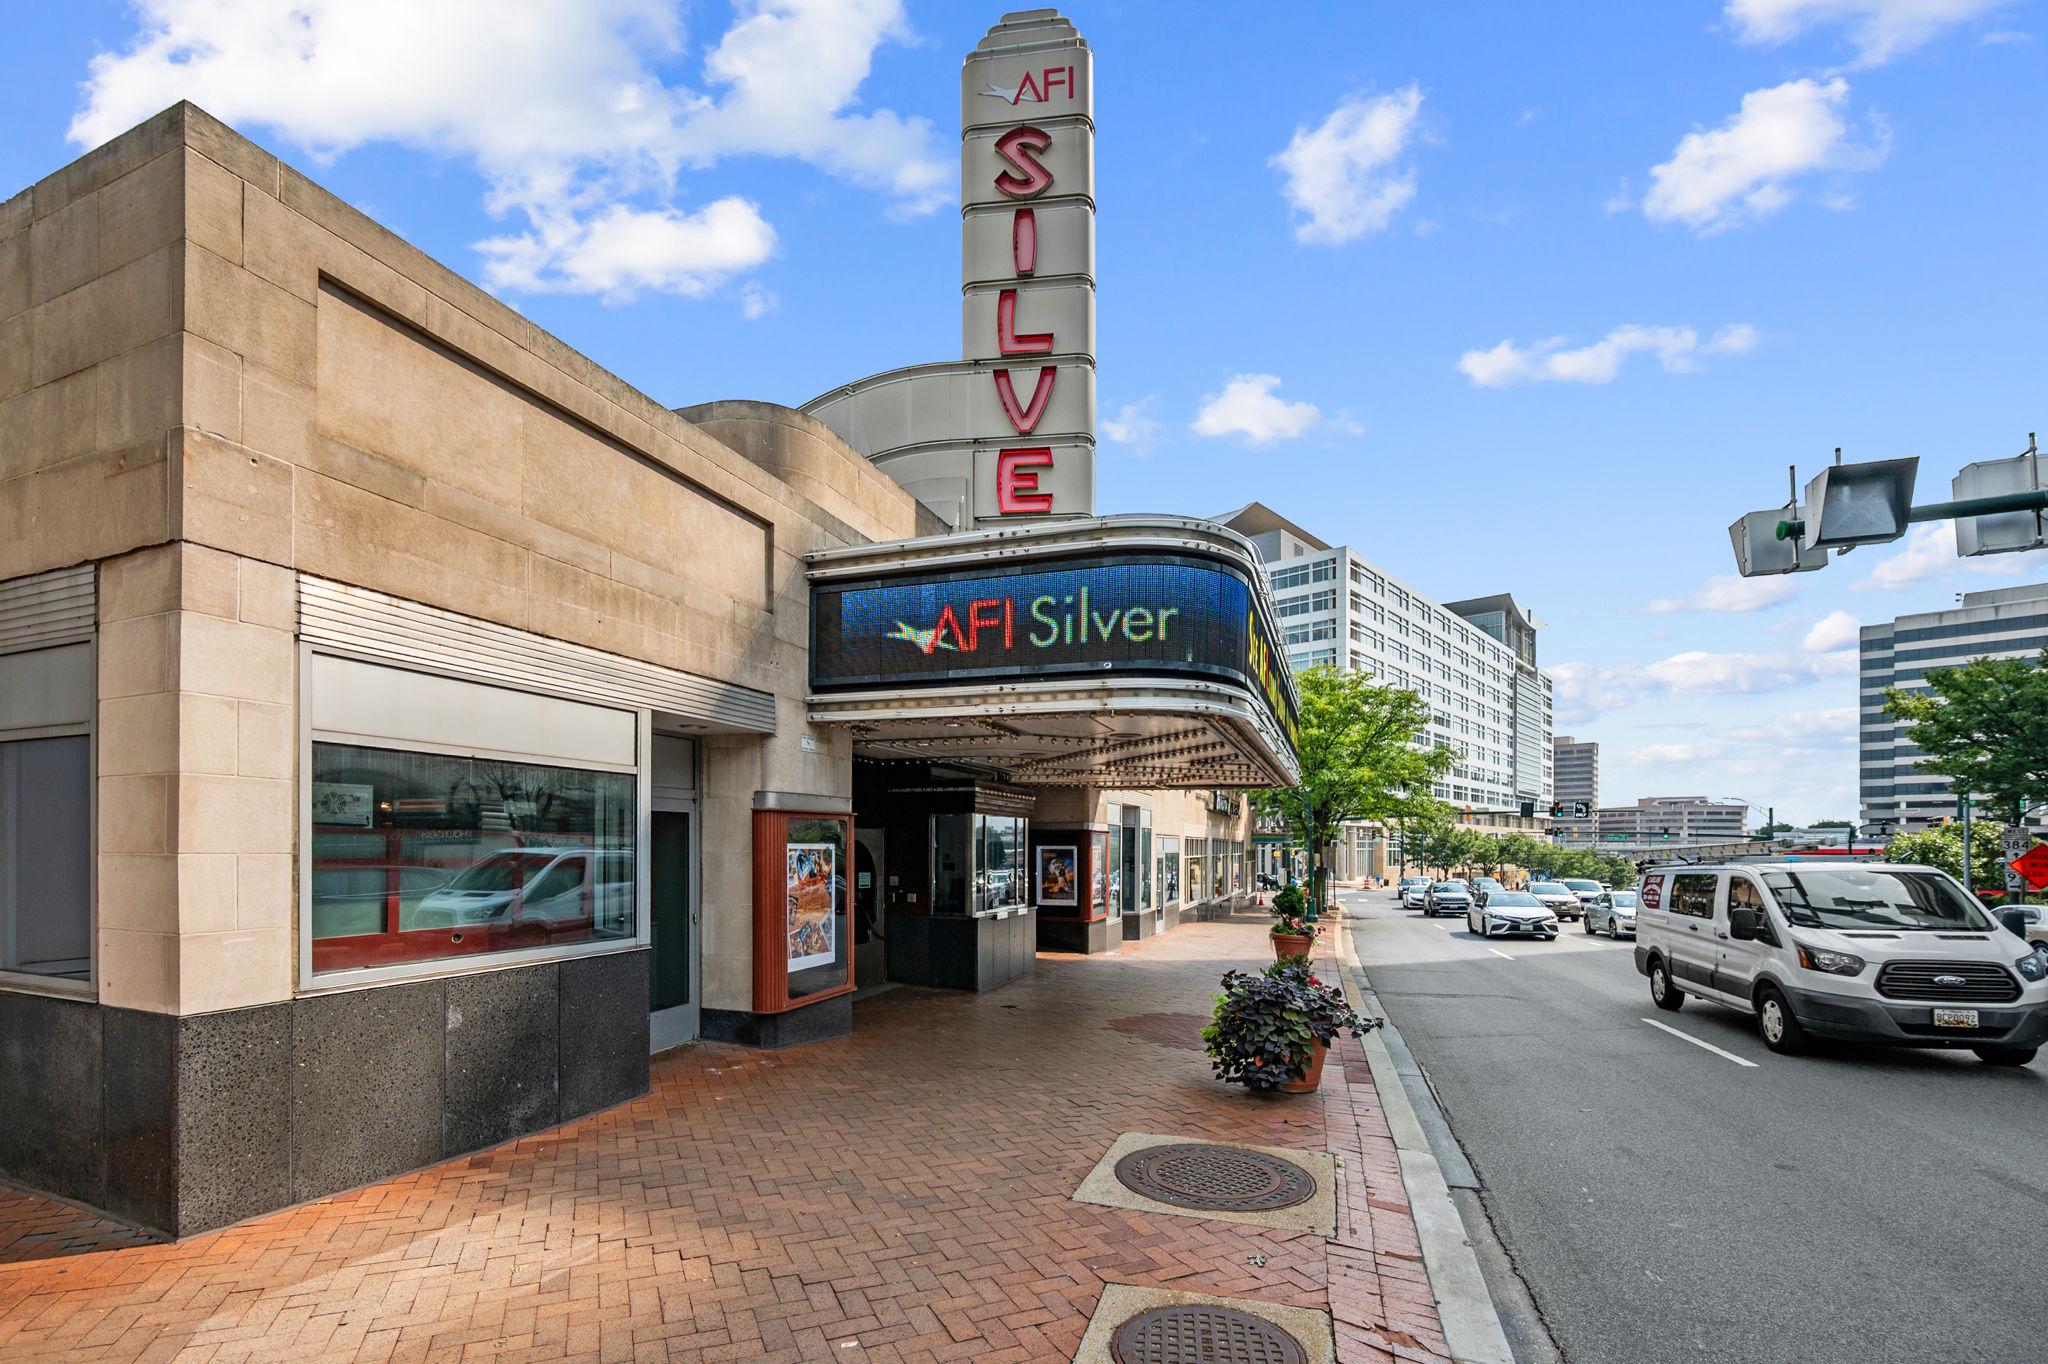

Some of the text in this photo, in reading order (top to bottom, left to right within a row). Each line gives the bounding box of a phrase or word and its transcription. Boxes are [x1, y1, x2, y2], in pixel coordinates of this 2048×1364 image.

[1011, 65, 1074, 106] AFI
[925, 586, 1180, 655] AFI Silver
[2003, 840, 2029, 850] 384
